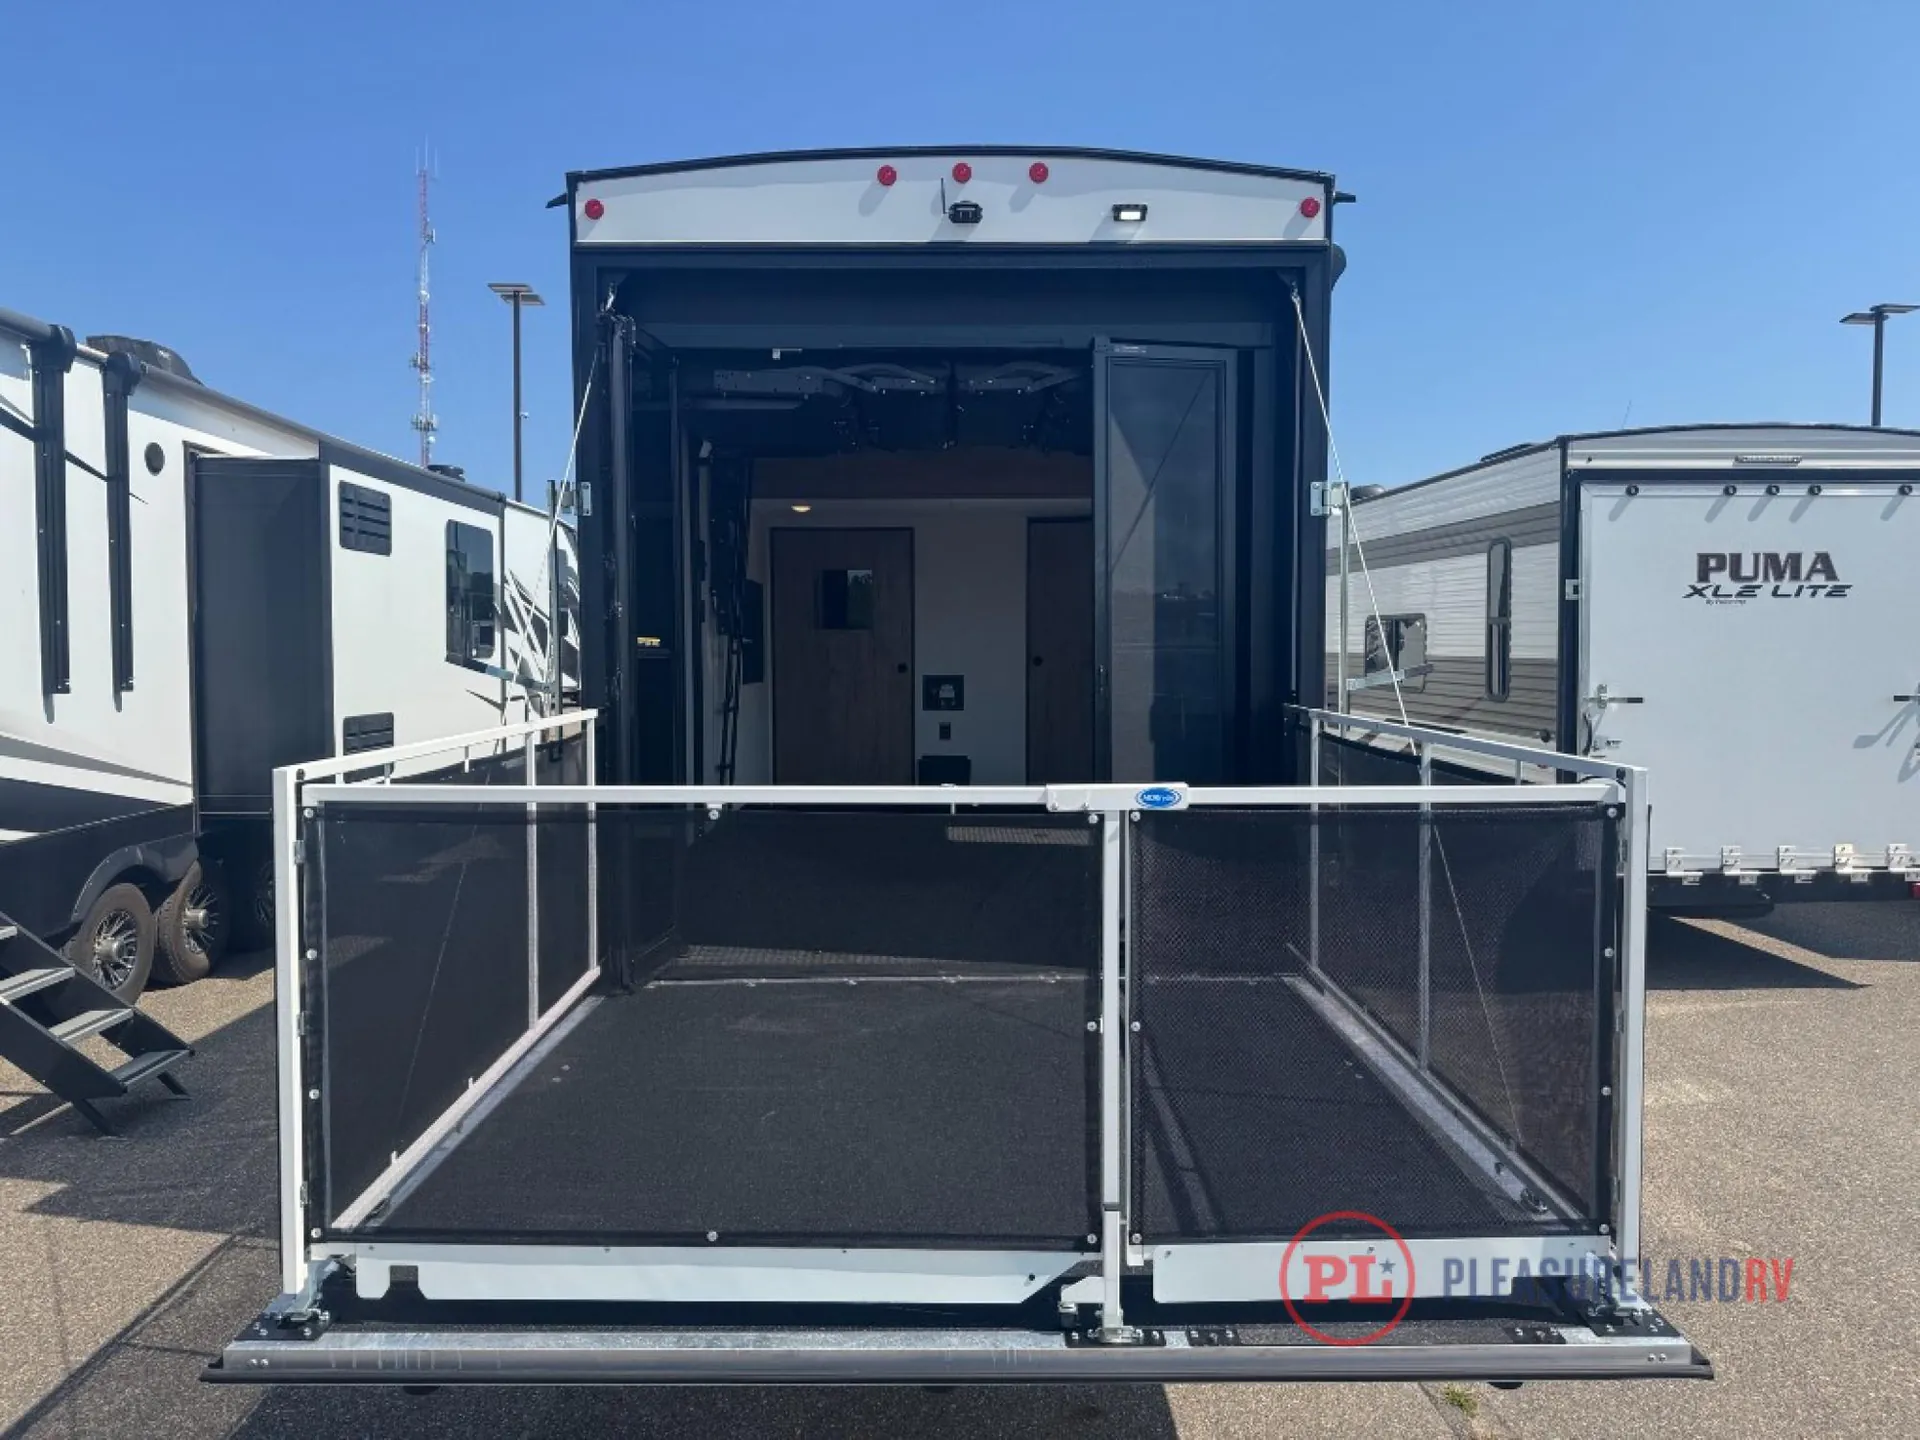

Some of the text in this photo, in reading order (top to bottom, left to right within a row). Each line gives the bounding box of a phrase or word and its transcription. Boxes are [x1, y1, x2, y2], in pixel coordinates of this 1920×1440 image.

[1696, 551, 1840, 583] PUMA
[1682, 584, 1853, 599] XLE LITE
